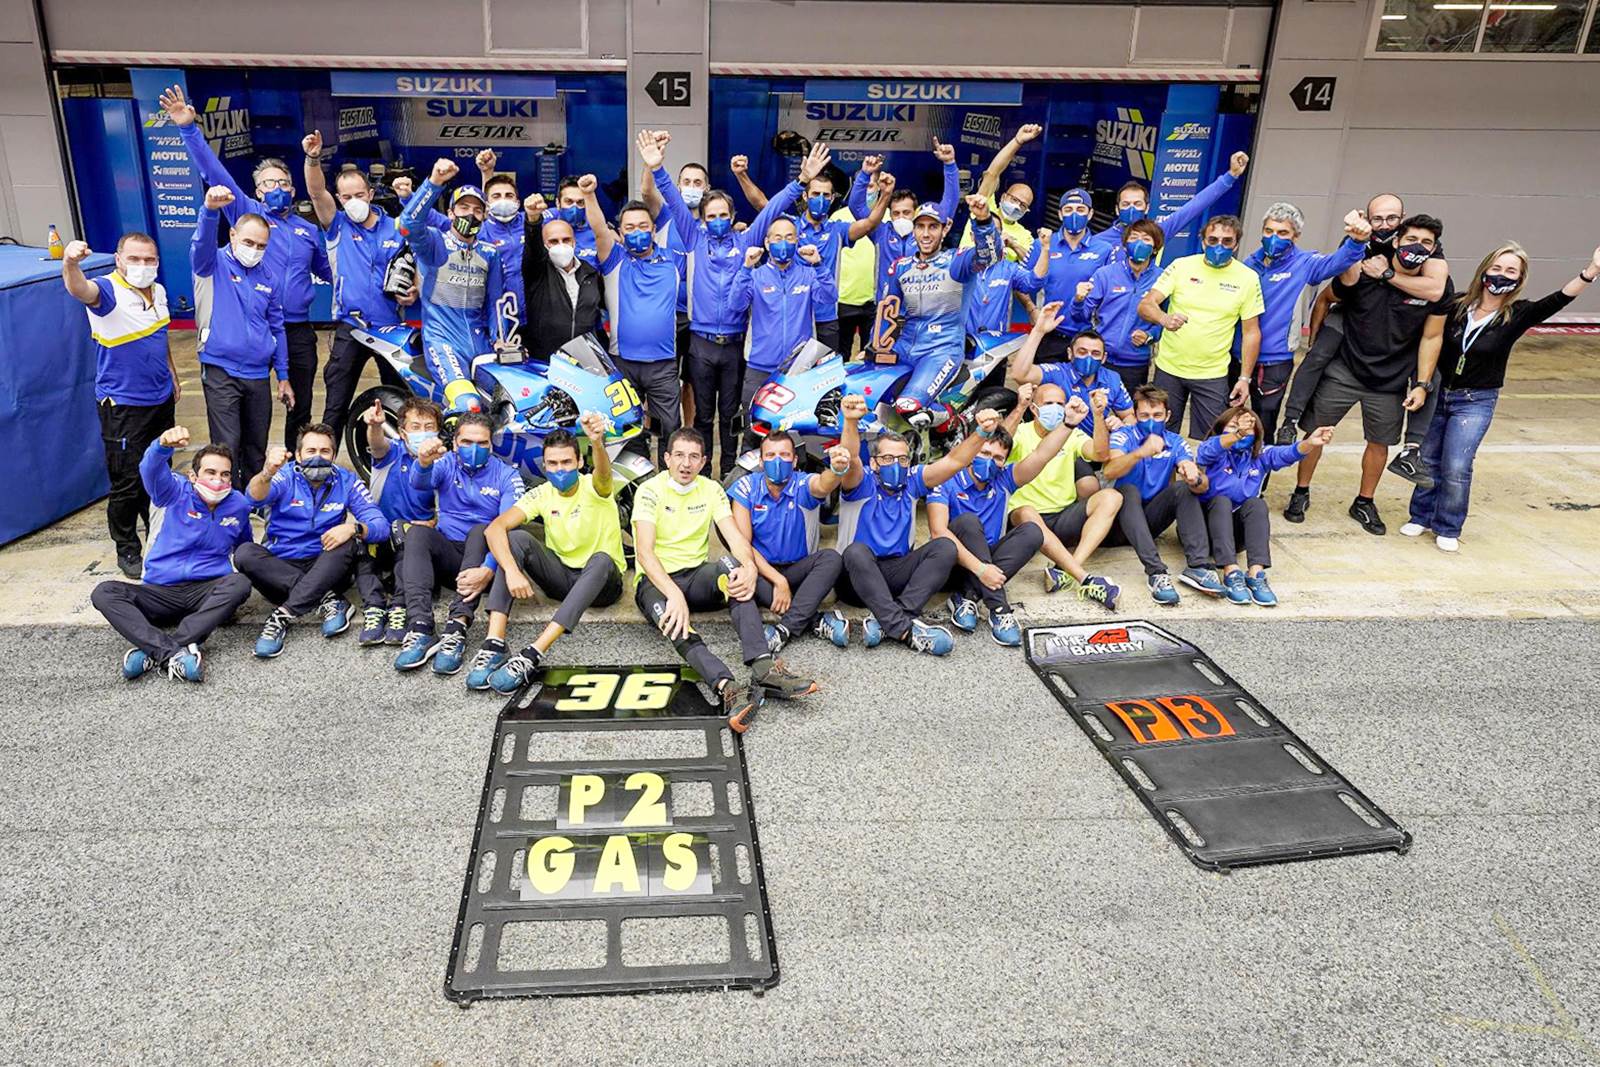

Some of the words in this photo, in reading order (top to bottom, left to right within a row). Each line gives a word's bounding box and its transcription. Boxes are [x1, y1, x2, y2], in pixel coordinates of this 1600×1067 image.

[396, 77, 493, 93] SUZUKI
[657, 77, 688, 101] 15
[867, 83, 961, 100] SUZUKI
[1303, 82, 1332, 106] 14
[426, 99, 538, 118] SUZUKI
[806, 103, 916, 122] SUZUKI
[340, 107, 376, 129] ECSTAR
[439, 125, 524, 138] ECSTAR
[815, 128, 900, 142] ECSTAR
[1095, 119, 1157, 152] SUZUKI
[1173, 126, 1211, 134] SUZUKI
[151, 151, 189, 161] MOTUL
[1163, 163, 1200, 172] MOTUL
[169, 205, 196, 216] Beta
[901, 273, 946, 285] SUZUKI
[927, 358, 956, 396] SUZUKI
[1087, 628, 1131, 645] 42
[1068, 640, 1145, 656] BAKERY
[554, 672, 677, 711] 36
[1116, 697, 1222, 741] P3
[568, 771, 668, 827] P2
[526, 832, 699, 895] GAS
